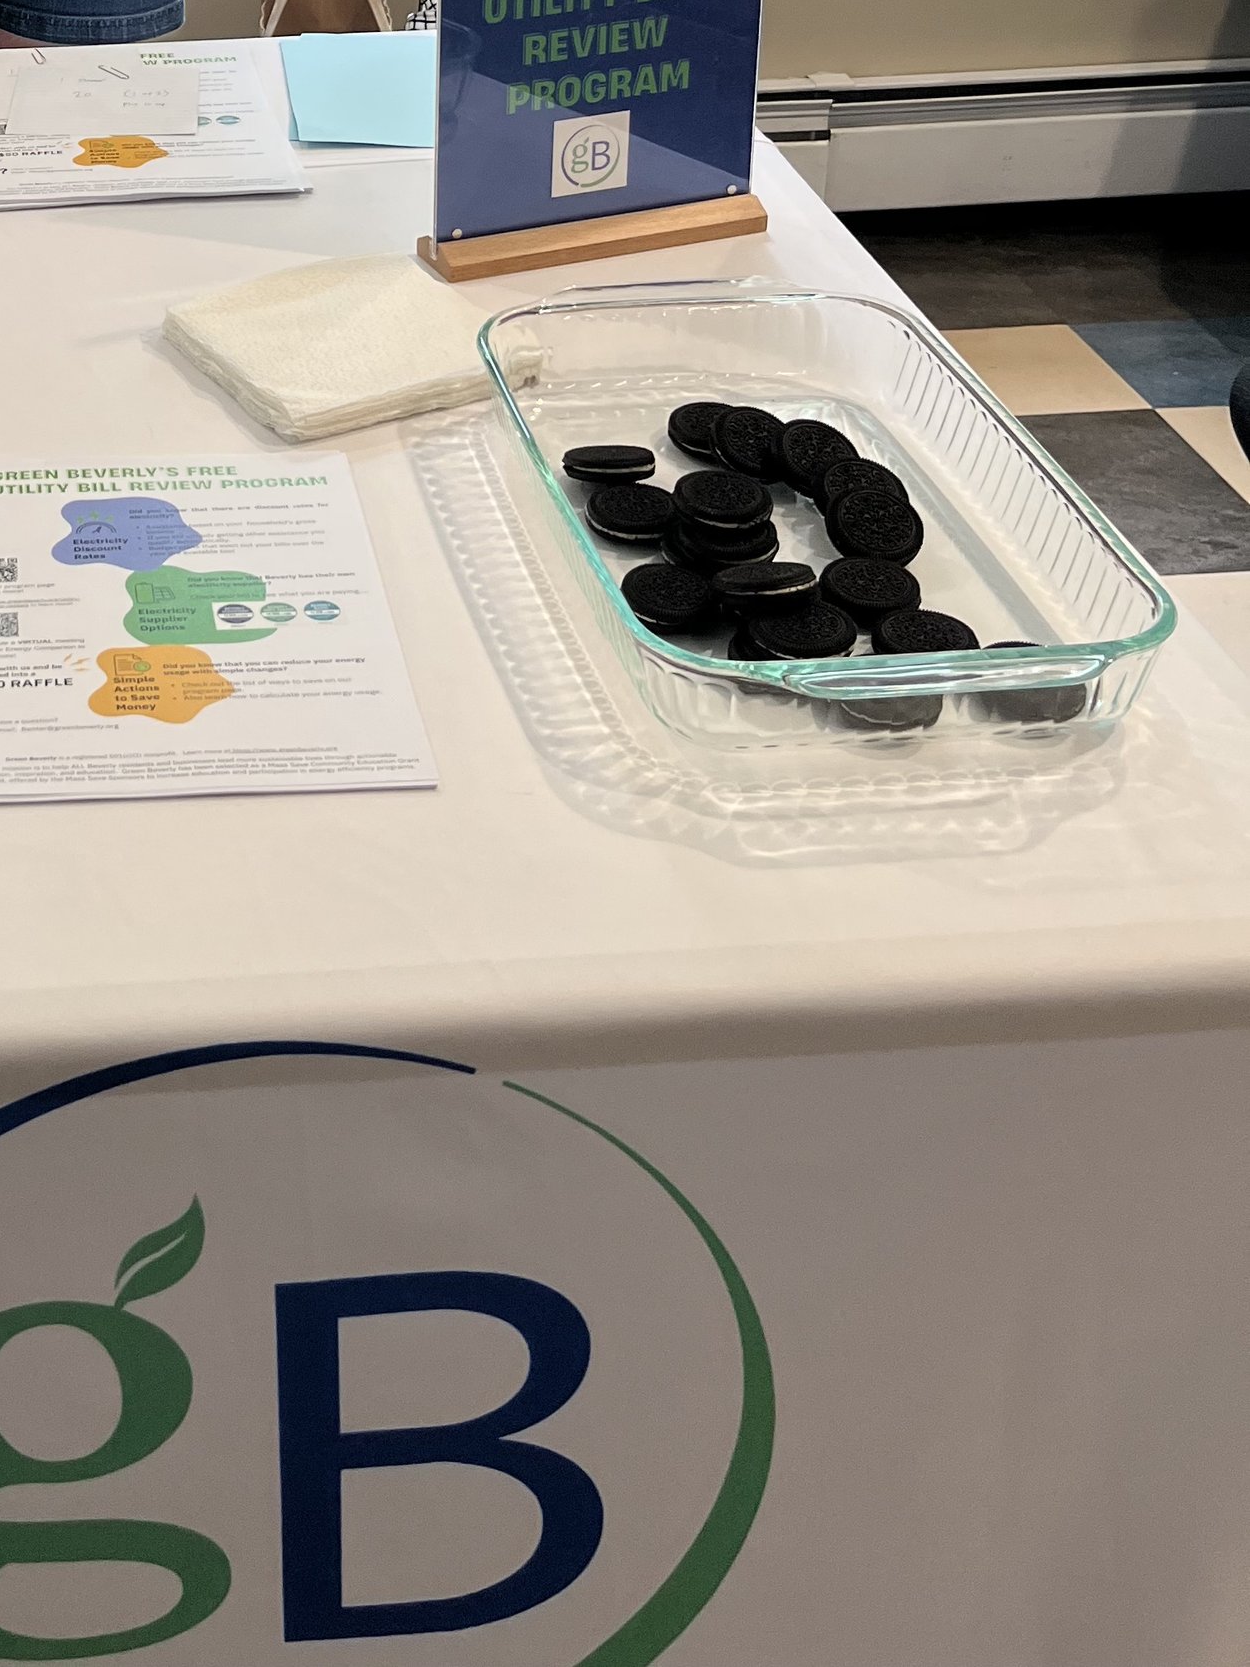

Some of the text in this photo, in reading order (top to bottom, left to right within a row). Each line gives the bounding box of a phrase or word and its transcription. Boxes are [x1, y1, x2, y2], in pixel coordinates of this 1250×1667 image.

[522, 14, 669, 66] REVIEW
[162, 57, 237, 65] PROGRAM
[506, 59, 691, 115] PROGRAM
[571, 138, 611, 175] gB
[67, 467, 178, 479] BEVERLY'S
[187, 466, 238, 476] FREE
[77, 482, 122, 493] BILL
[129, 480, 212, 491] REVIEW
[221, 476, 329, 489] PROGRAM
[139, 607, 196, 615] Electricity
[140, 624, 185, 632] Options
[11, 677, 74, 688] RAFFLE
[113, 676, 155, 684] Simple
[116, 703, 157, 711] Money
